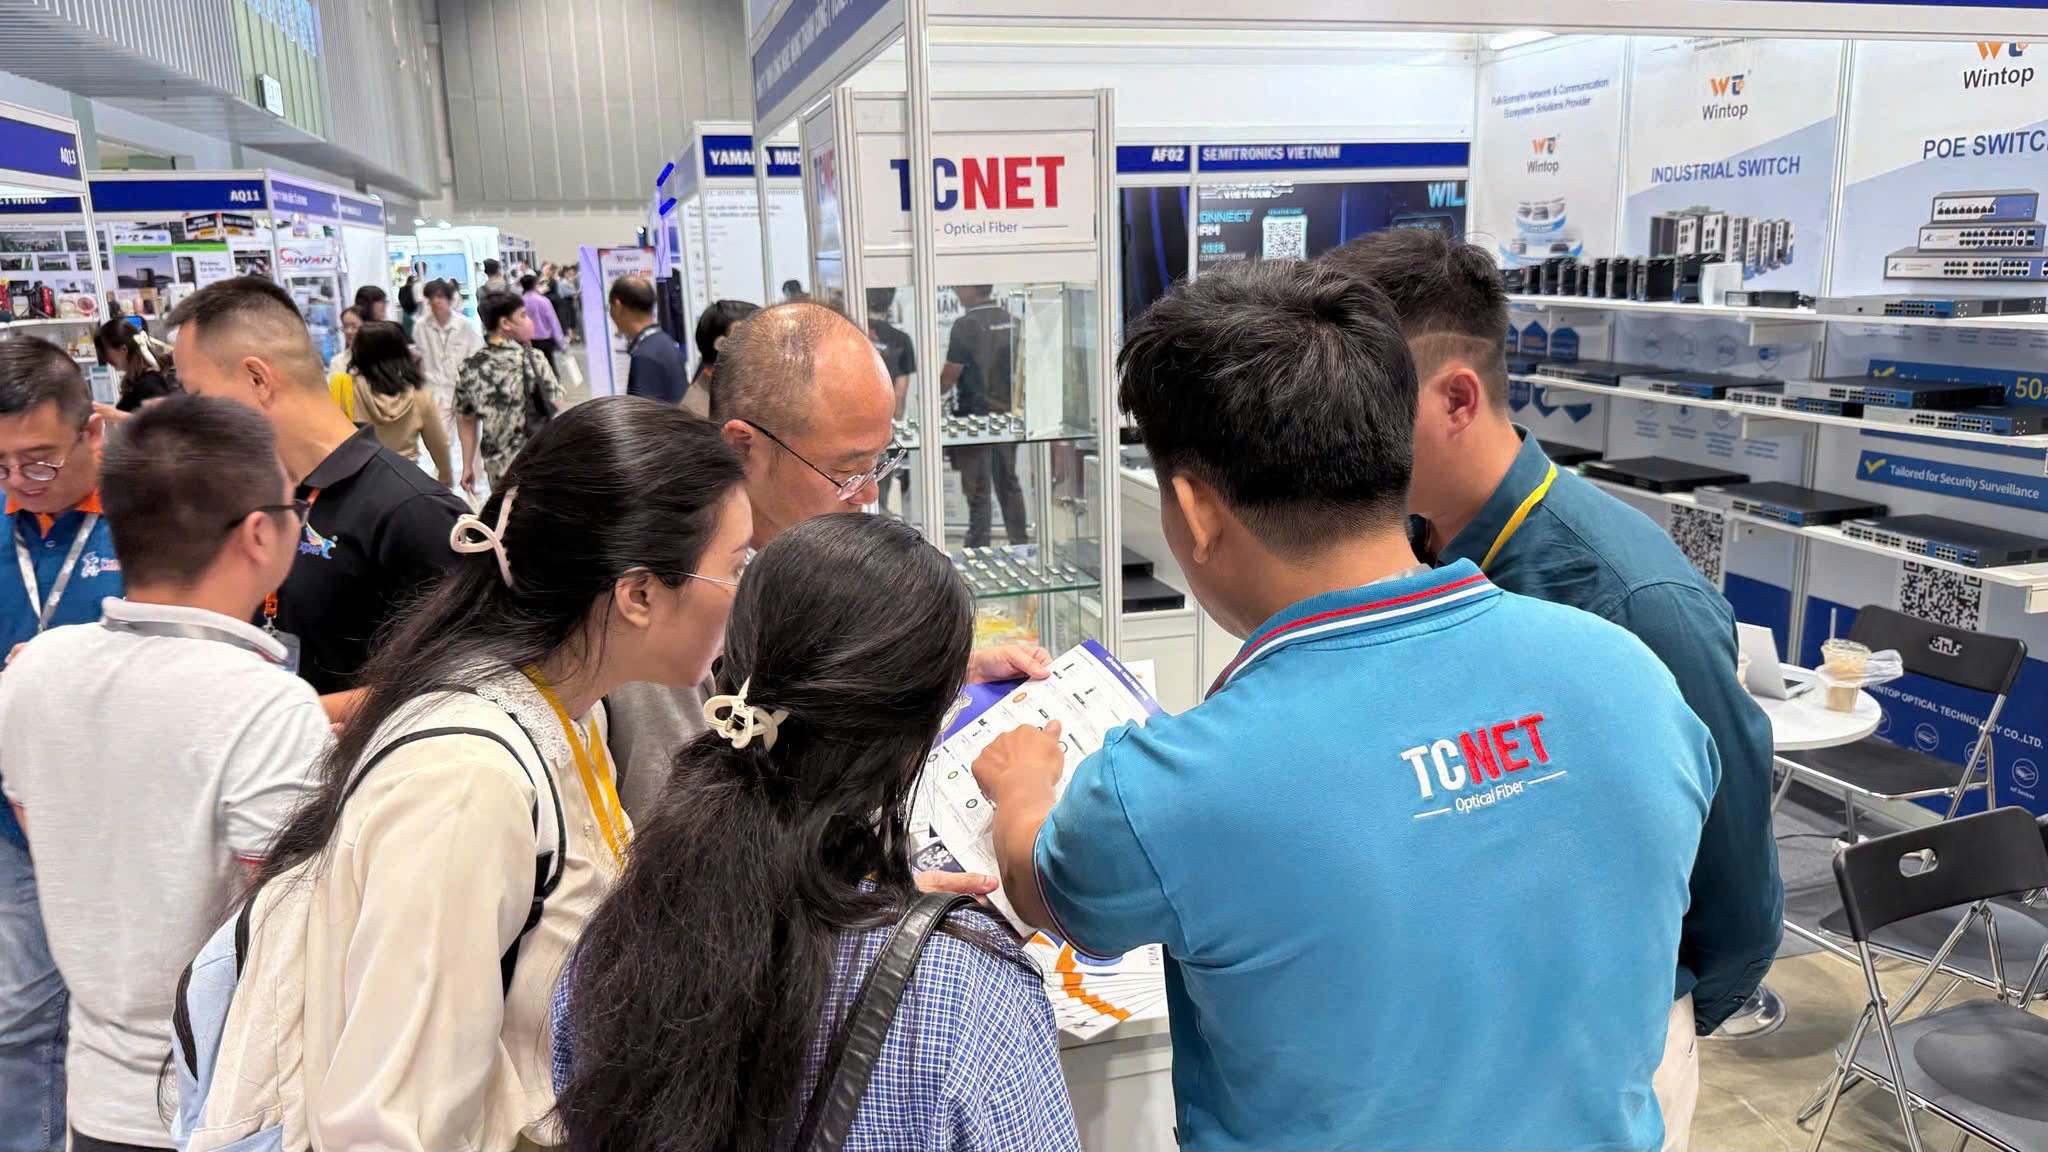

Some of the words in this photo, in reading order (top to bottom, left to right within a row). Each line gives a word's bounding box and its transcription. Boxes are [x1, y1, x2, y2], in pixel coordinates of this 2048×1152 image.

[1963, 67, 2034, 89] Wintop
[1702, 103, 1749, 121] Wintop
[1151, 147, 1185, 162] AF02
[1202, 146, 1284, 162] SEMITRONICS
[1287, 144, 1342, 160] VIETNAM
[1923, 136, 1967, 160] POE
[1972, 129, 2048, 156] SWITC
[1527, 160, 1559, 175] Wintop
[1651, 161, 1734, 183] INDUSTRIAL
[1738, 155, 1801, 177] SWITCH
[890, 156, 1065, 211] TCNET
[230, 189, 261, 202] AQ11
[943, 222, 986, 236] Optical
[988, 221, 1018, 234] Fiber
[1890, 464, 1925, 480] Tailored
[1926, 472, 1939, 482] for
[1941, 473, 1978, 491] Security
[1979, 480, 2040, 500] Surveillance
[1901, 693, 1938, 713] OPTICAL
[1400, 712, 1549, 799] TCNET
[1455, 789, 1495, 814] Optical
[1496, 781, 1525, 798] Fiber
